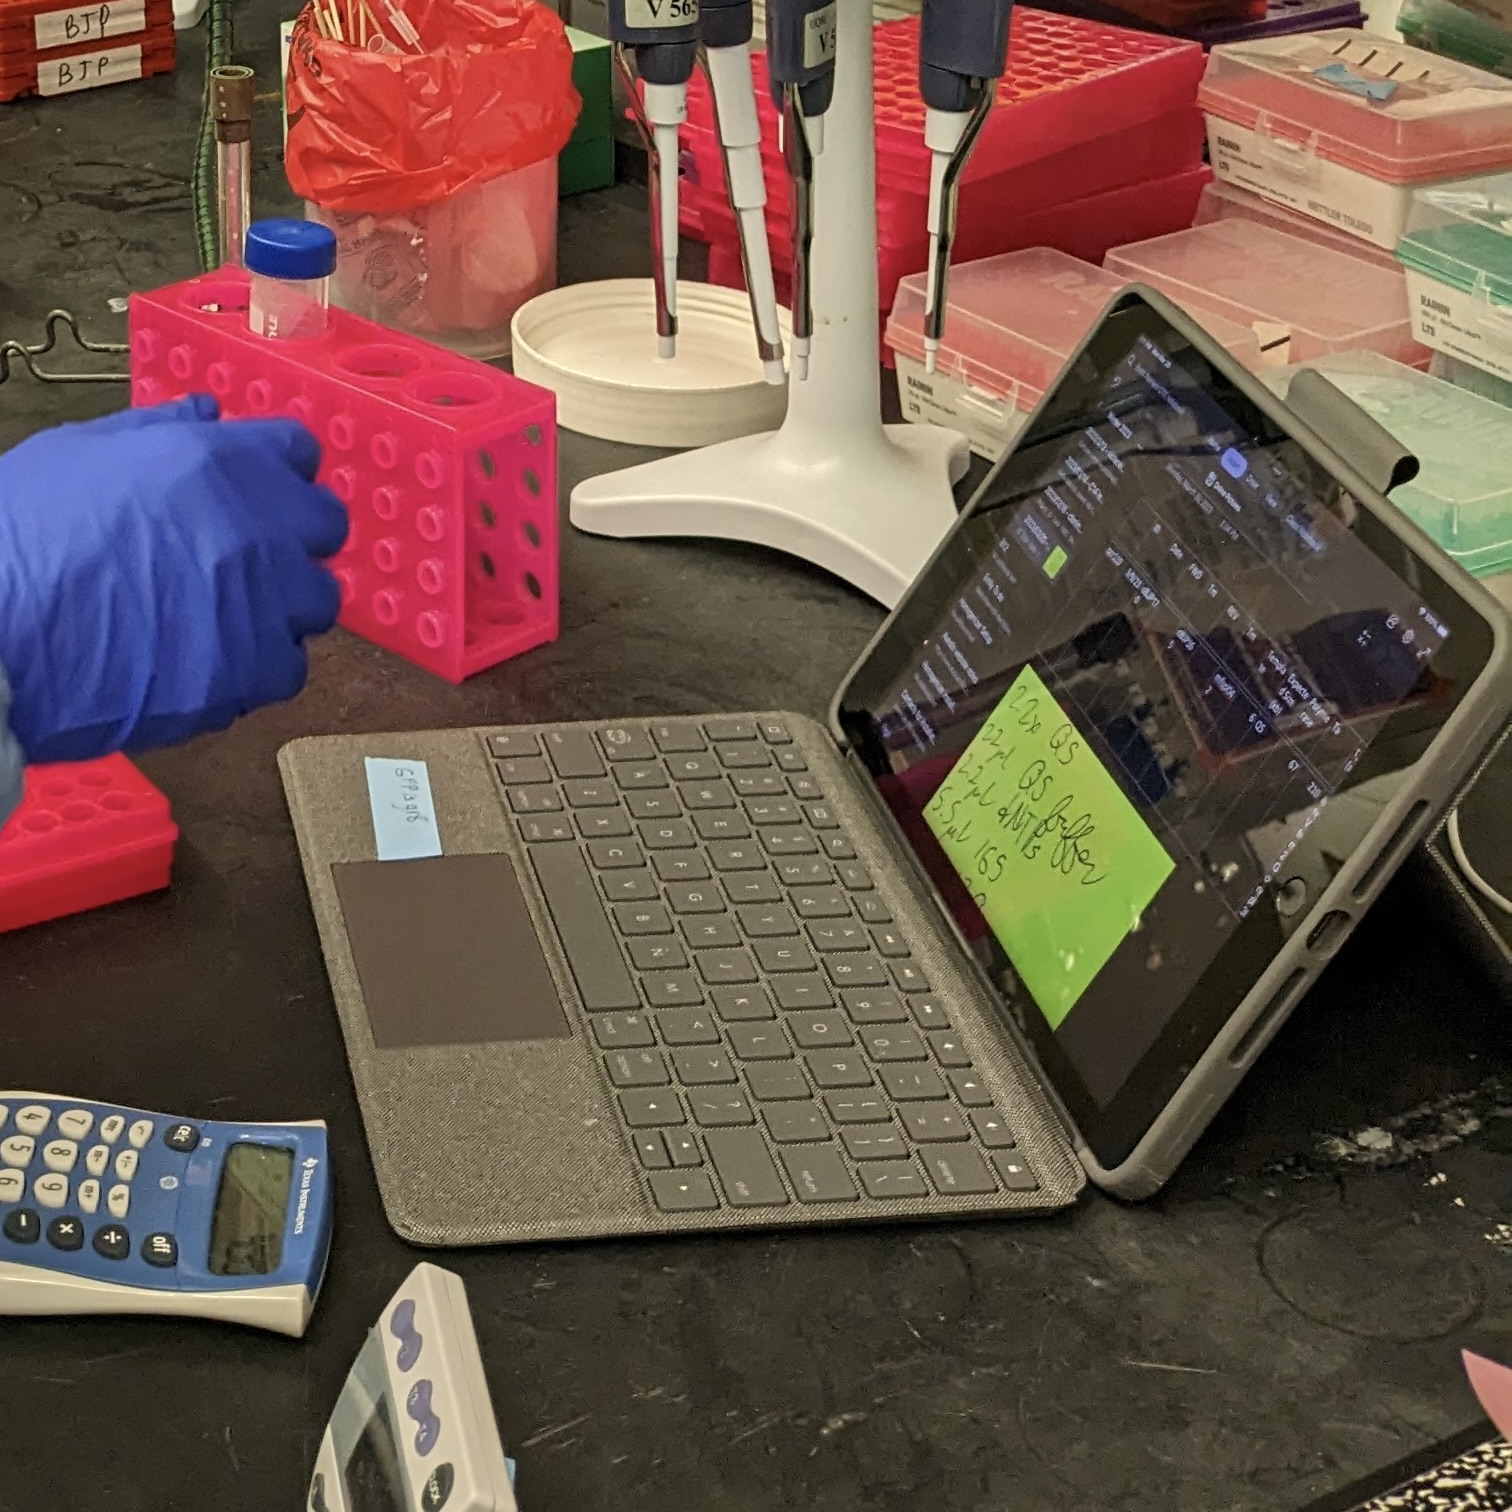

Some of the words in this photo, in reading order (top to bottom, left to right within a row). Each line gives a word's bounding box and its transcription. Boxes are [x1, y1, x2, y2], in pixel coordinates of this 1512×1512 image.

[646, 0, 665, 19] V
[64, 3, 111, 40] BJP
[817, 33, 829, 54] V
[152, 1236, 171, 1254] off
